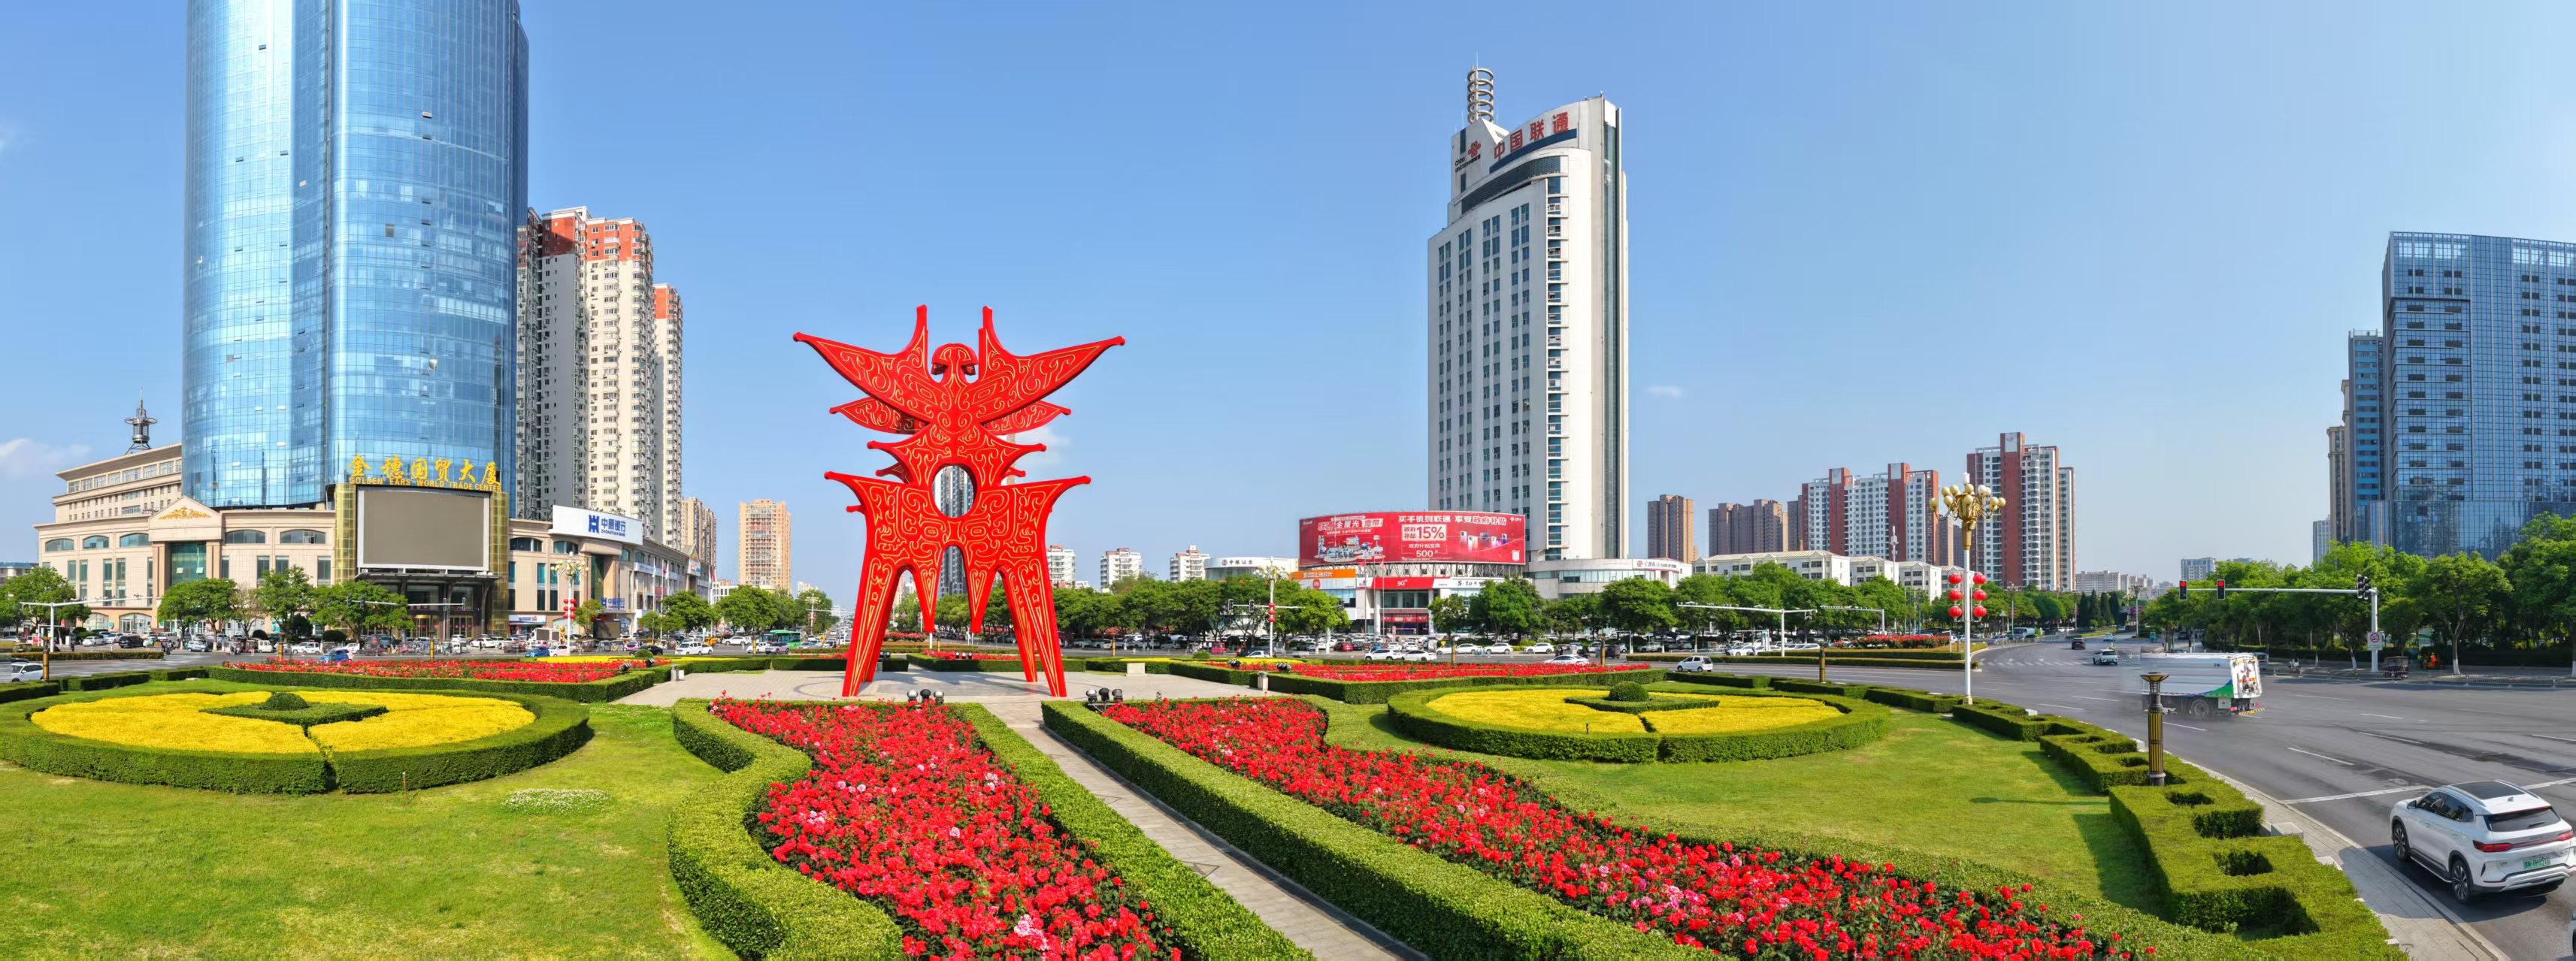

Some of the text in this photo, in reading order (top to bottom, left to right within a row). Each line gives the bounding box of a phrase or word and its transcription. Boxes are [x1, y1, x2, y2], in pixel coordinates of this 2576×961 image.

[1494, 111, 1570, 161] 中国联通
[347, 454, 501, 485] 金穗国贸大厦
[349, 476, 502, 493] GOLDEN EARS WORLD TRADE CENTER
[601, 518, 626, 533] 中原银行
[1397, 515, 1451, 524] 买手机到联通
[1454, 515, 1507, 526] 享受政府补贴
[1416, 526, 1445, 539] 15%
